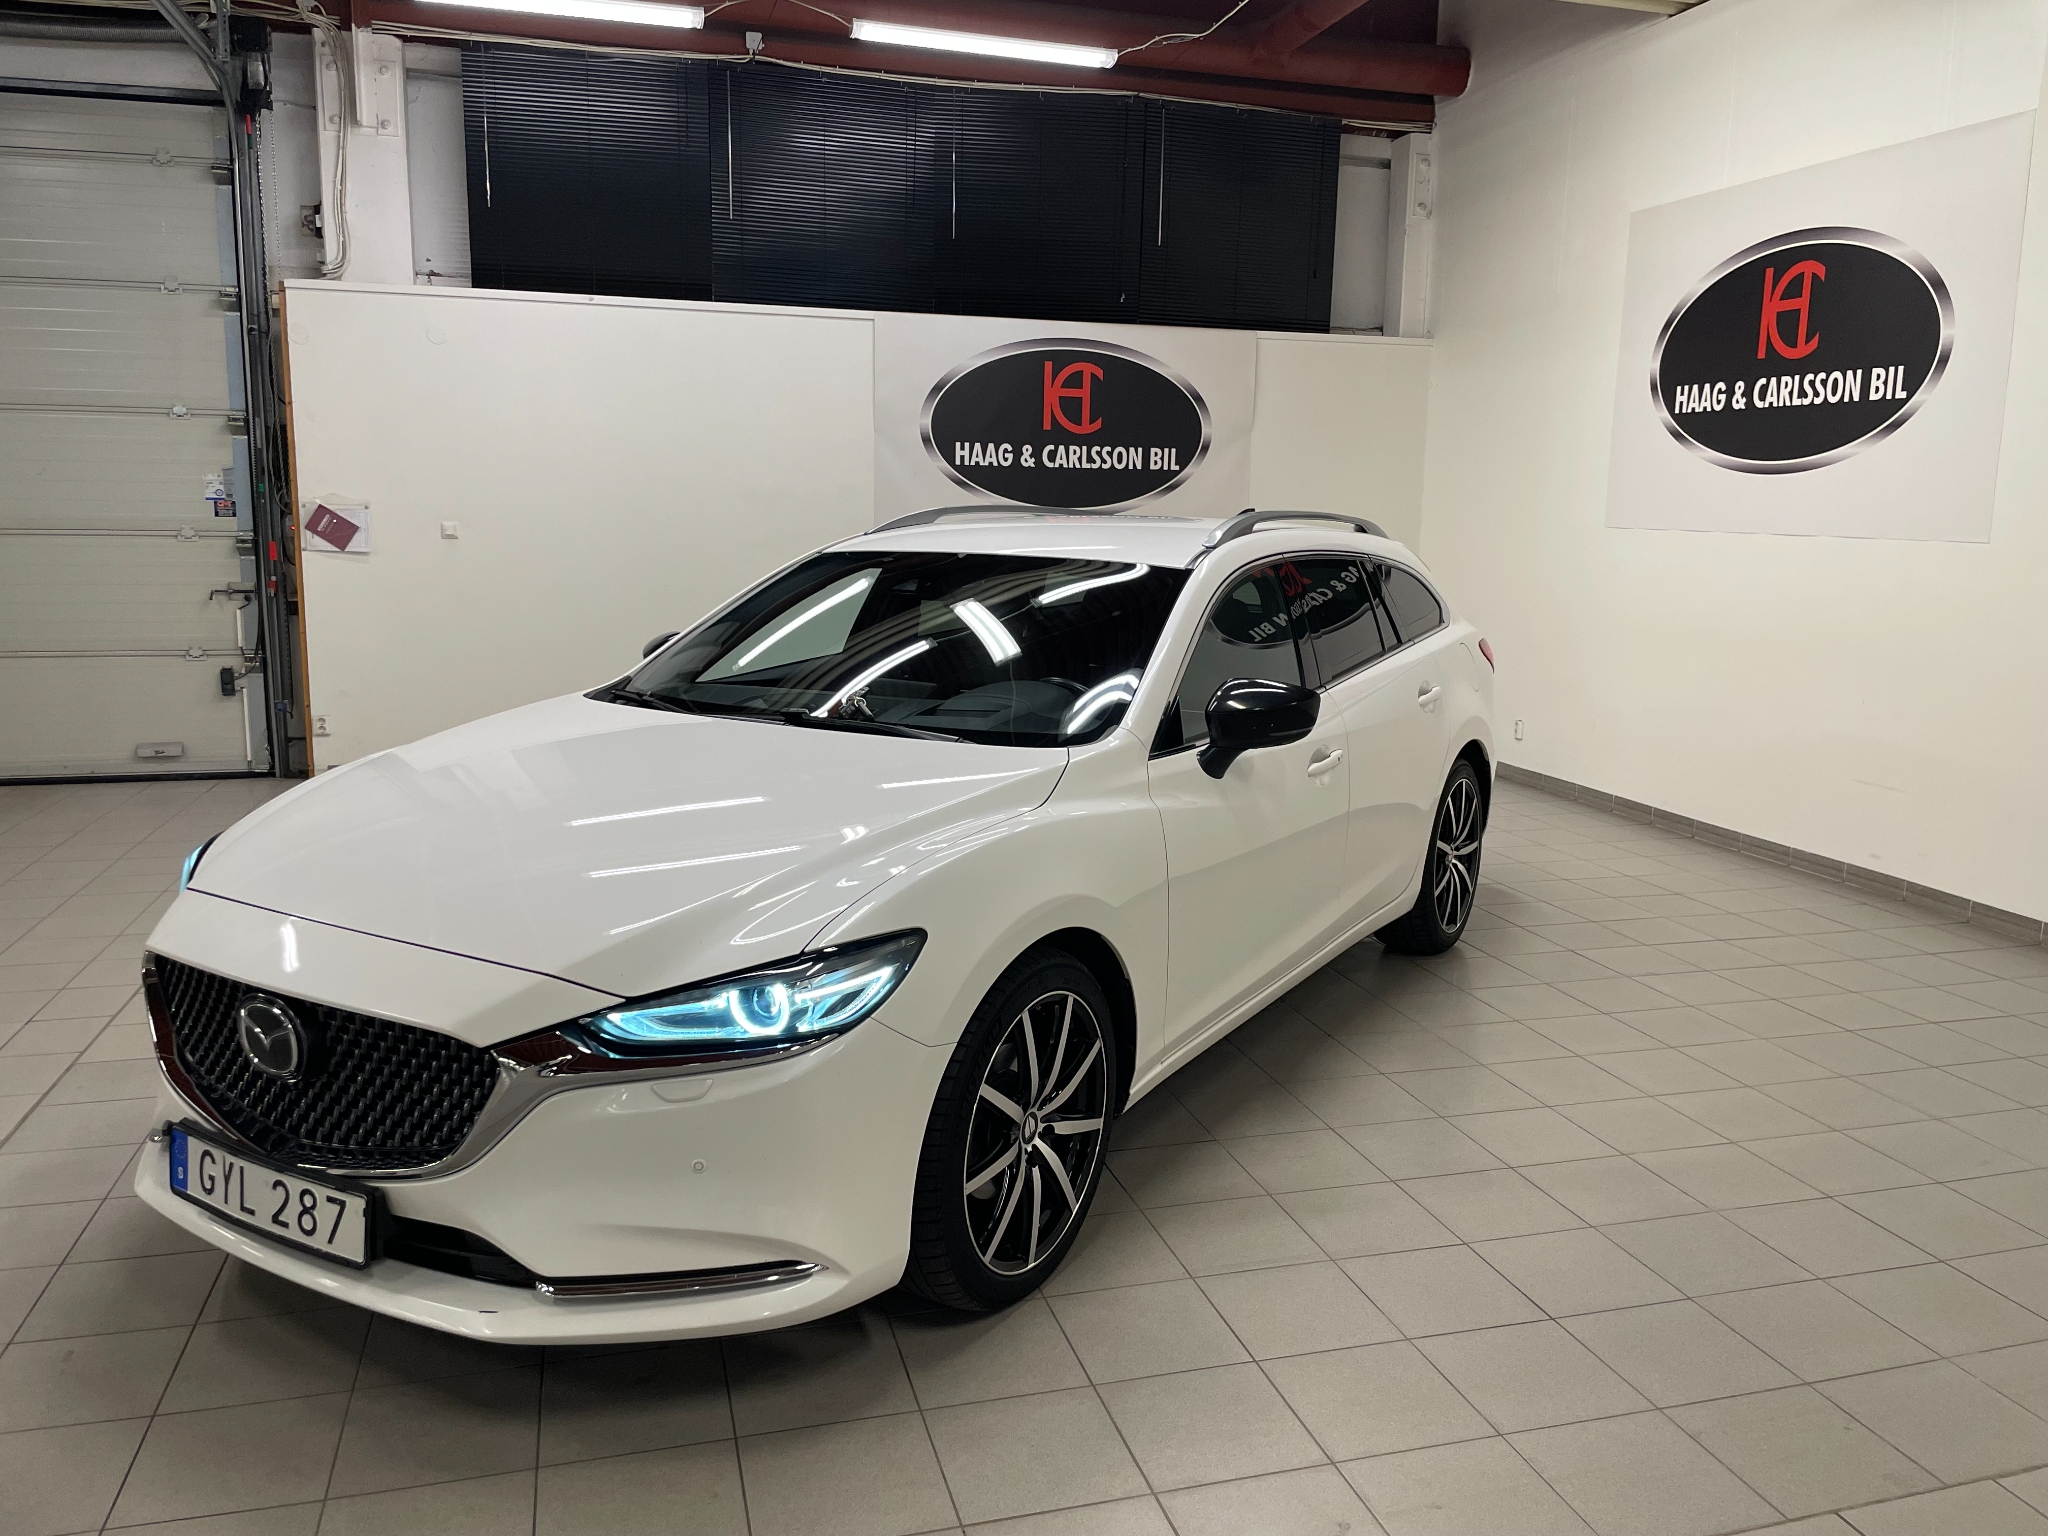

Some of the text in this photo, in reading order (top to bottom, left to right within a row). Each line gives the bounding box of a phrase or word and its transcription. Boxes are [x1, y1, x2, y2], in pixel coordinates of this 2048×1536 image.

[1674, 365, 1907, 414] HAAG & CARLSSON BIL
[955, 442, 1180, 471] HAAG & CARLSSON BIL
[178, 1166, 184, 1179] S
[199, 1149, 347, 1245] GYL 287
